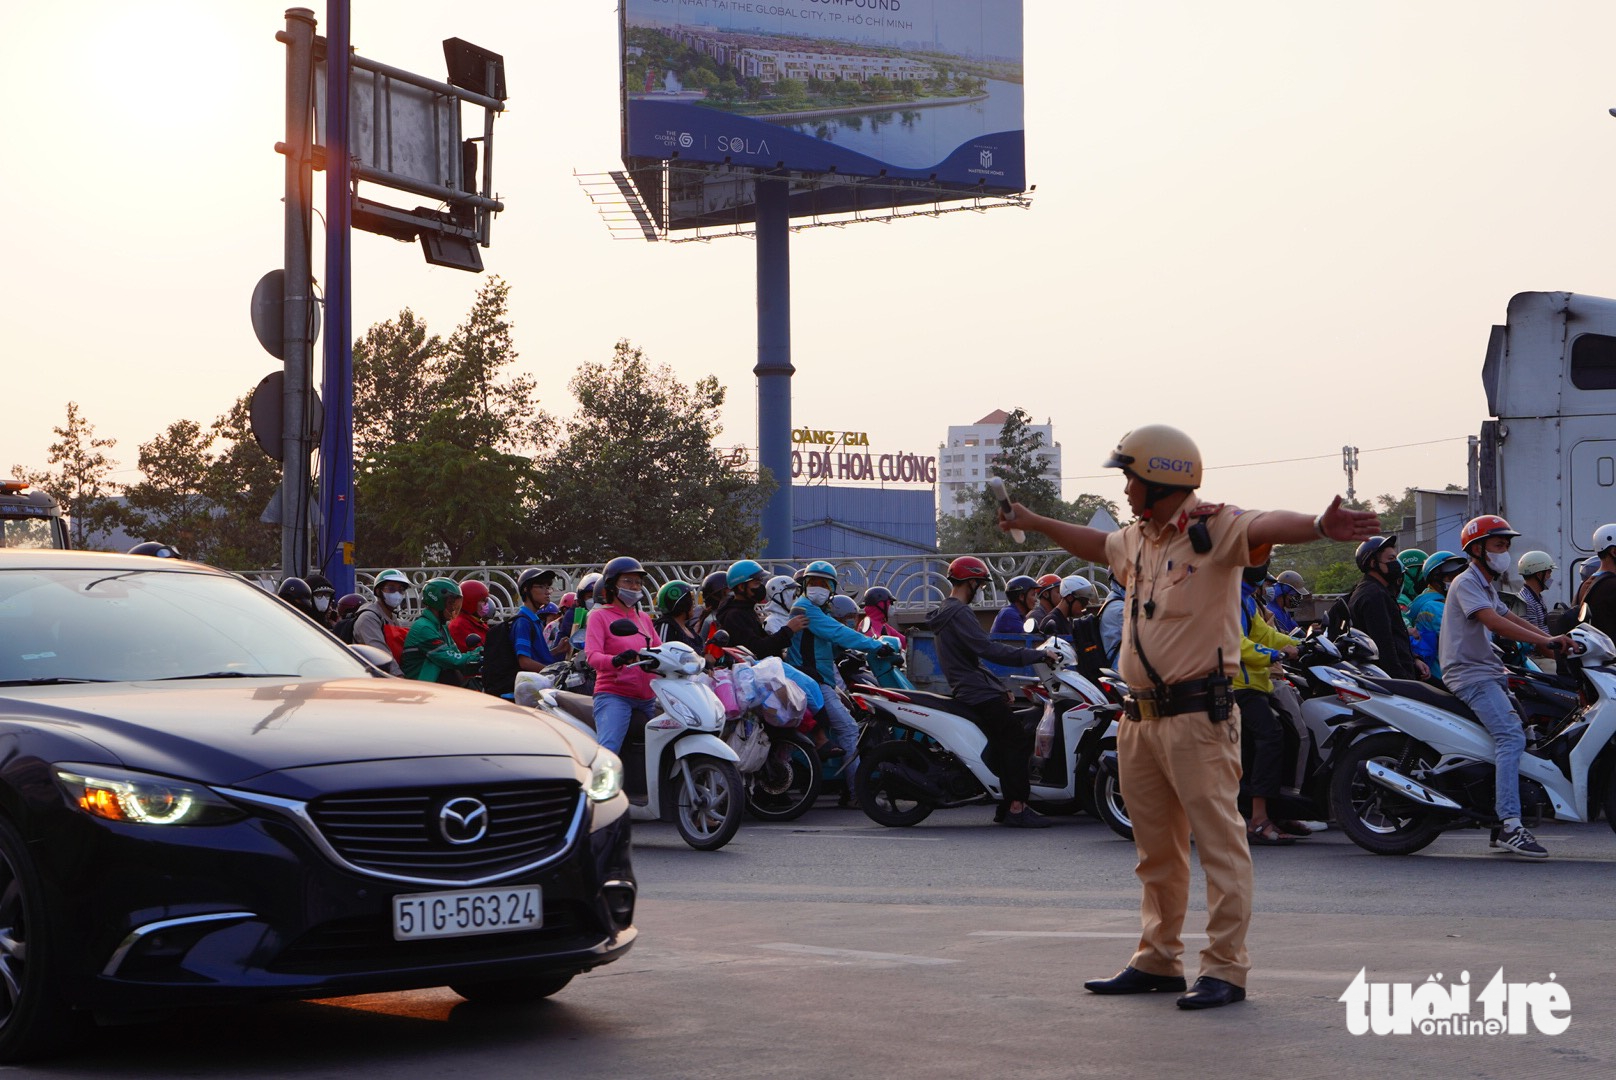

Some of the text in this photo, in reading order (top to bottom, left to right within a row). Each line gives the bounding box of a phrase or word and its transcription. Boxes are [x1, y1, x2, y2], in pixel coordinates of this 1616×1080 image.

[730, 2, 753, 13] THE
[756, 4, 798, 18] GLOBAL
[886, 19, 913, 30] MINH
[717, 135, 770, 155] SOLA
[791, 426, 869, 446] OÀNG GIA
[807, 446, 833, 479] ĐÁ
[838, 452, 874, 480] HOA
[878, 450, 937, 483] CƯƠNG
[1149, 456, 1193, 474] CSGT
[1402, 556, 1419, 564] Grab
[400, 891, 536, 934] 51G-563.24
